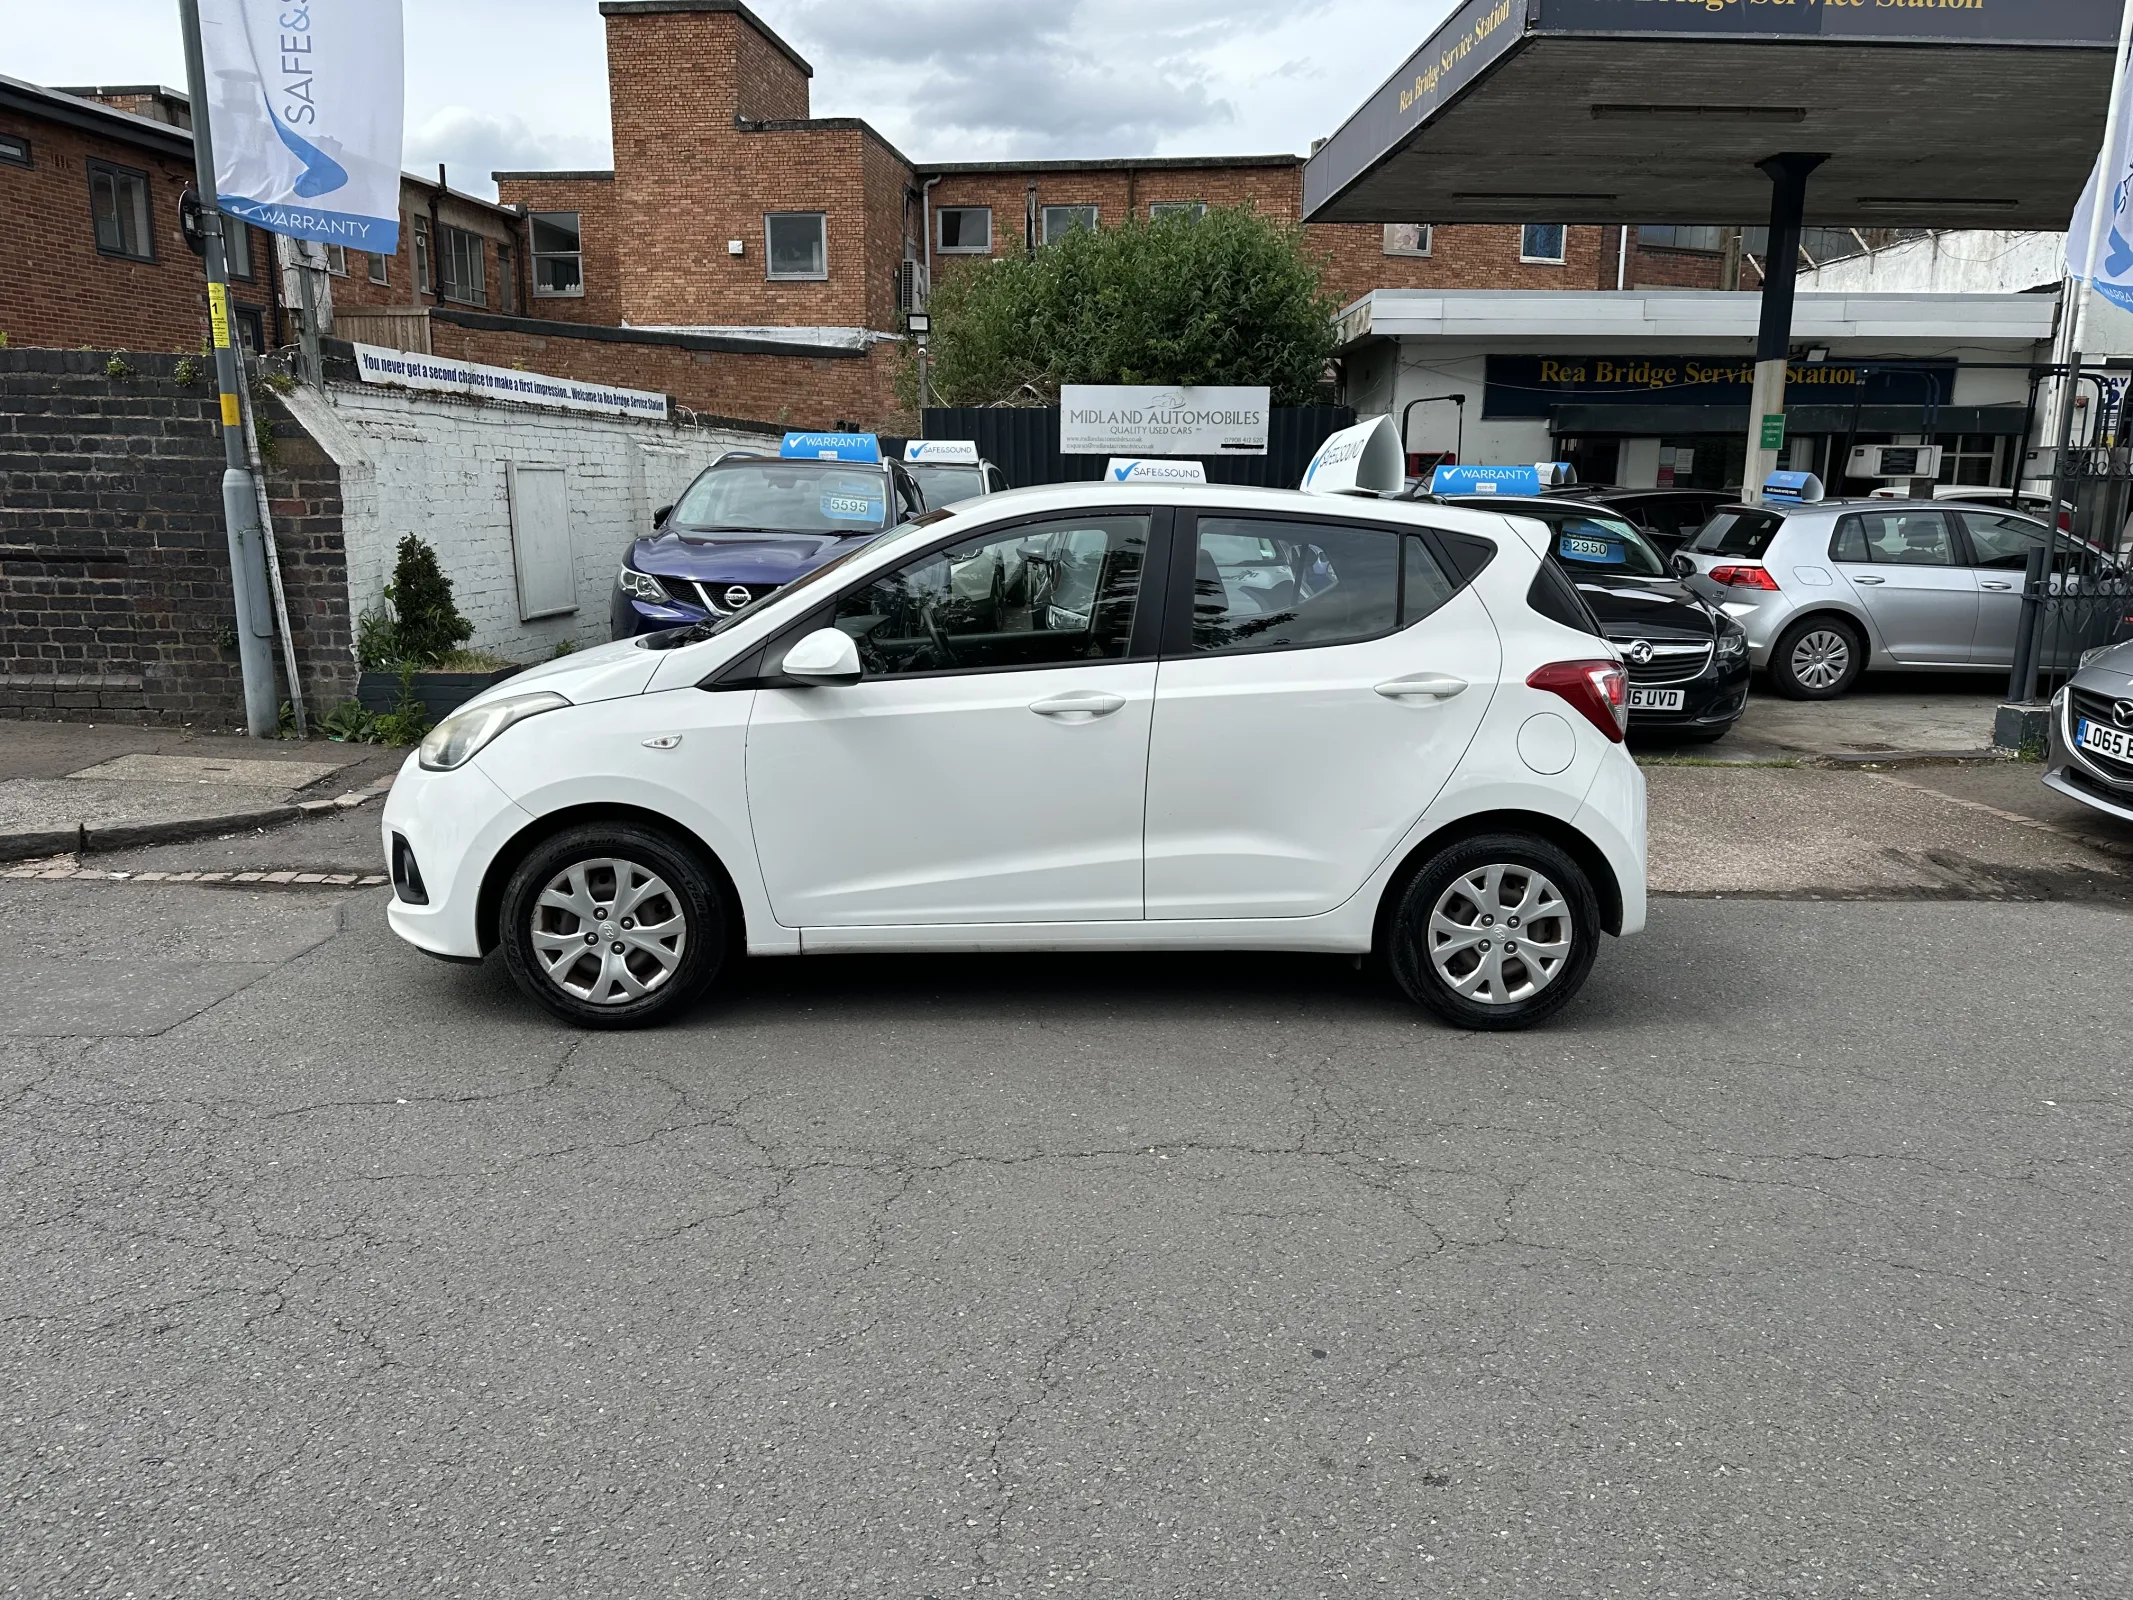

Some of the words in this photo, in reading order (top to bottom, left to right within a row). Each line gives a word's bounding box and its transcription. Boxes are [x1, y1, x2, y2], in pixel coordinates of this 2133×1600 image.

[279, 0, 316, 125] SAFE&
[1399, 89, 1413, 114] Rea
[1415, 64, 1440, 101] Bridge
[1440, 33, 1473, 76] Service
[1474, 0, 1510, 45] Station
[259, 208, 370, 238] WARRANTY
[212, 302, 218, 315] 1
[363, 353, 379, 370] You
[381, 358, 405, 375] never
[407, 362, 421, 377] get
[423, 367, 428, 377] a
[429, 367, 457, 383] second
[458, 369, 485, 385] chance
[486, 376, 493, 387] to
[494, 376, 513, 390] make
[514, 381, 519, 391] a
[519, 379, 534, 393] first
[571, 387, 597, 403] Welcome
[597, 393, 603, 404] to
[603, 392, 613, 405] Rea
[613, 393, 630, 408] Bridge
[630, 395, 648, 409] Service
[648, 398, 664, 411] Station
[1539, 361, 1586, 383] Rea
[1595, 361, 1677, 388] Bridge
[1684, 361, 1754, 384] Servic
[1069, 410, 1143, 425] MIDLAND
[1147, 410, 1260, 425] AUTOMOBILES
[1110, 426, 1147, 435] QUALITY
[1149, 426, 1169, 435] USED
[1170, 426, 1193, 435] CARS
[805, 437, 871, 448] WARRANTY
[923, 446, 972, 454] SAFE&SOUND
[1133, 467, 1200, 478] SAFE&SOUND
[1460, 469, 1531, 480] WARRANTY
[1646, 690, 1678, 707] UVD
